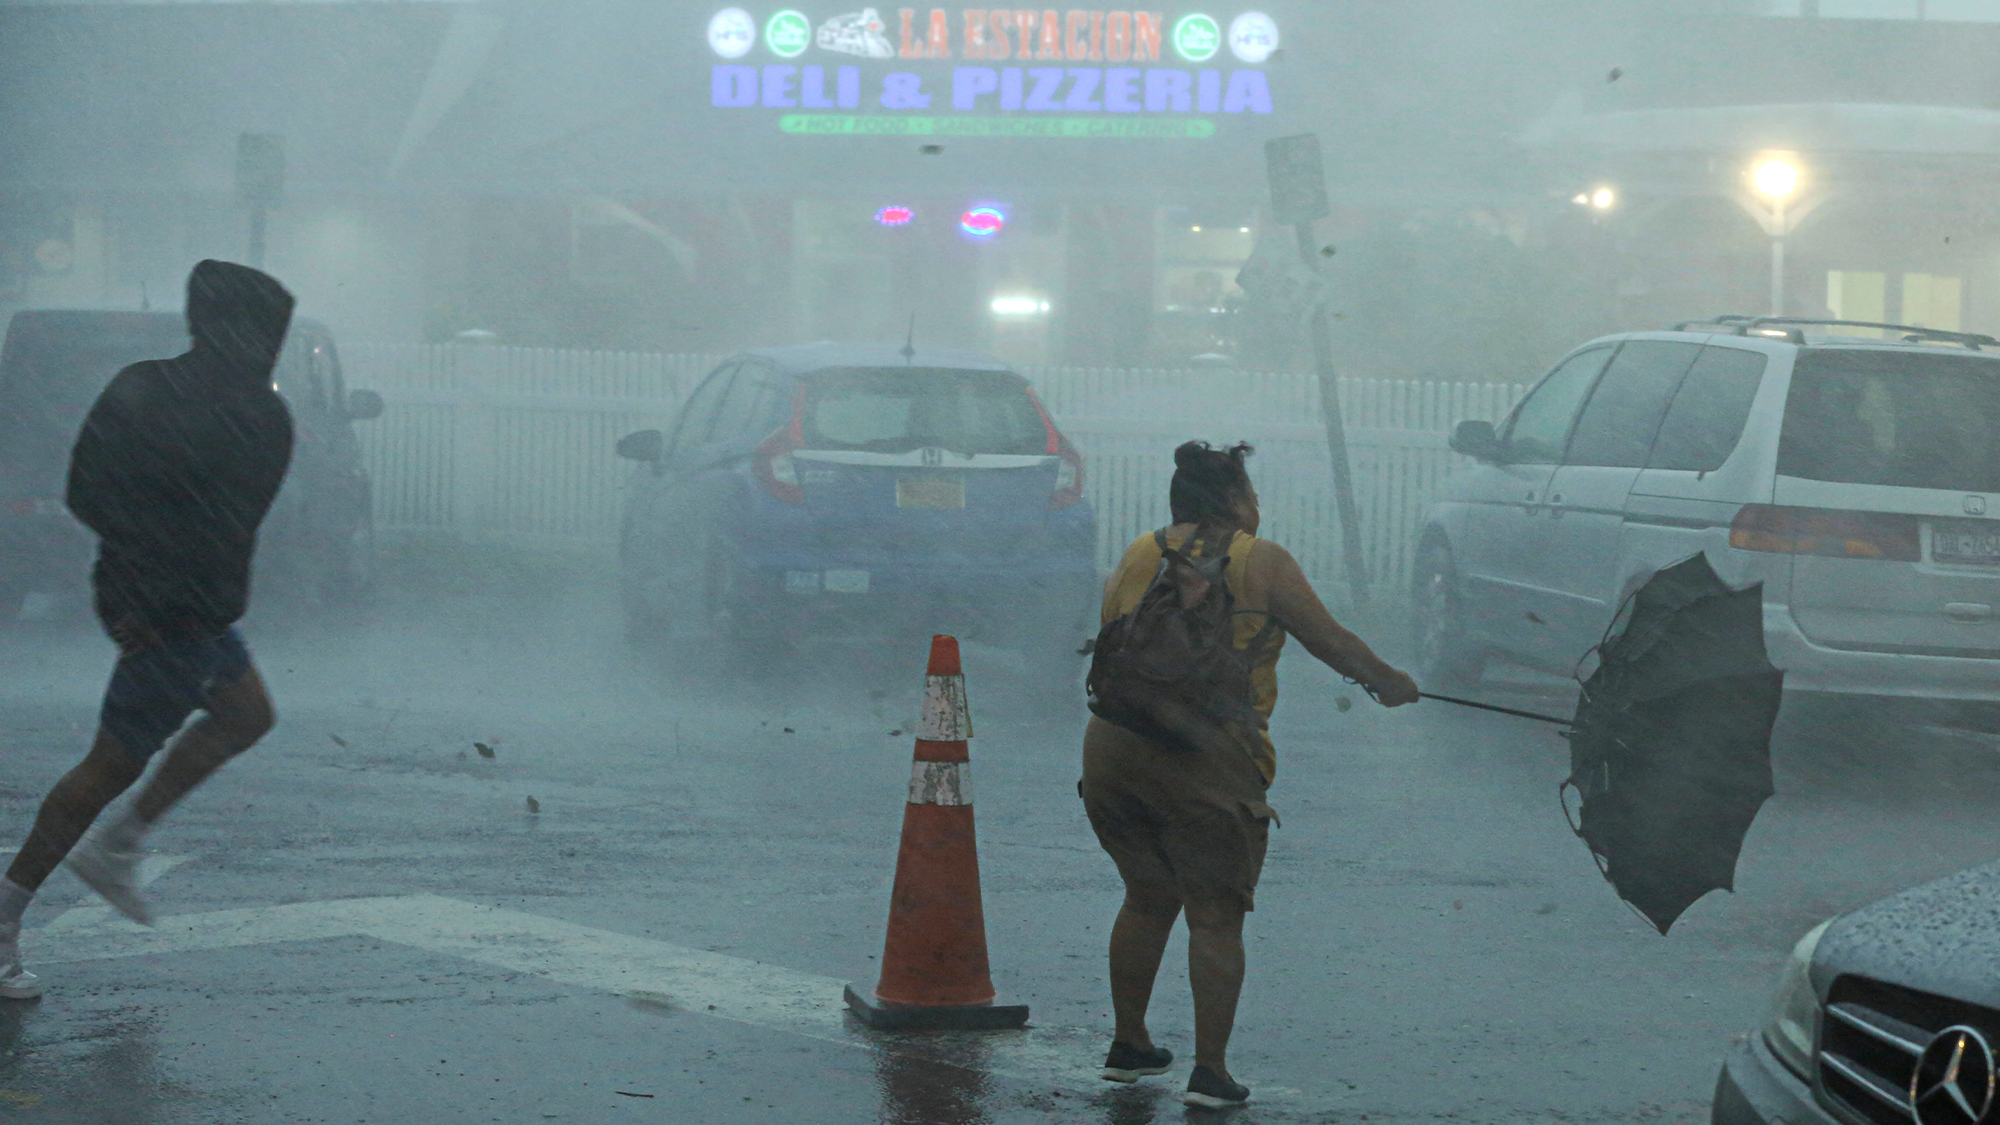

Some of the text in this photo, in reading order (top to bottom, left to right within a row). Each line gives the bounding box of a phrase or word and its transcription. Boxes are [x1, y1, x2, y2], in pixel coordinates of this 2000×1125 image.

[898, 8, 1164, 62] LA ESTACION
[712, 65, 1273, 113] DELI & PIZZERIA
[805, 115, 846, 133] HOT
[851, 115, 909, 133] FOOD
